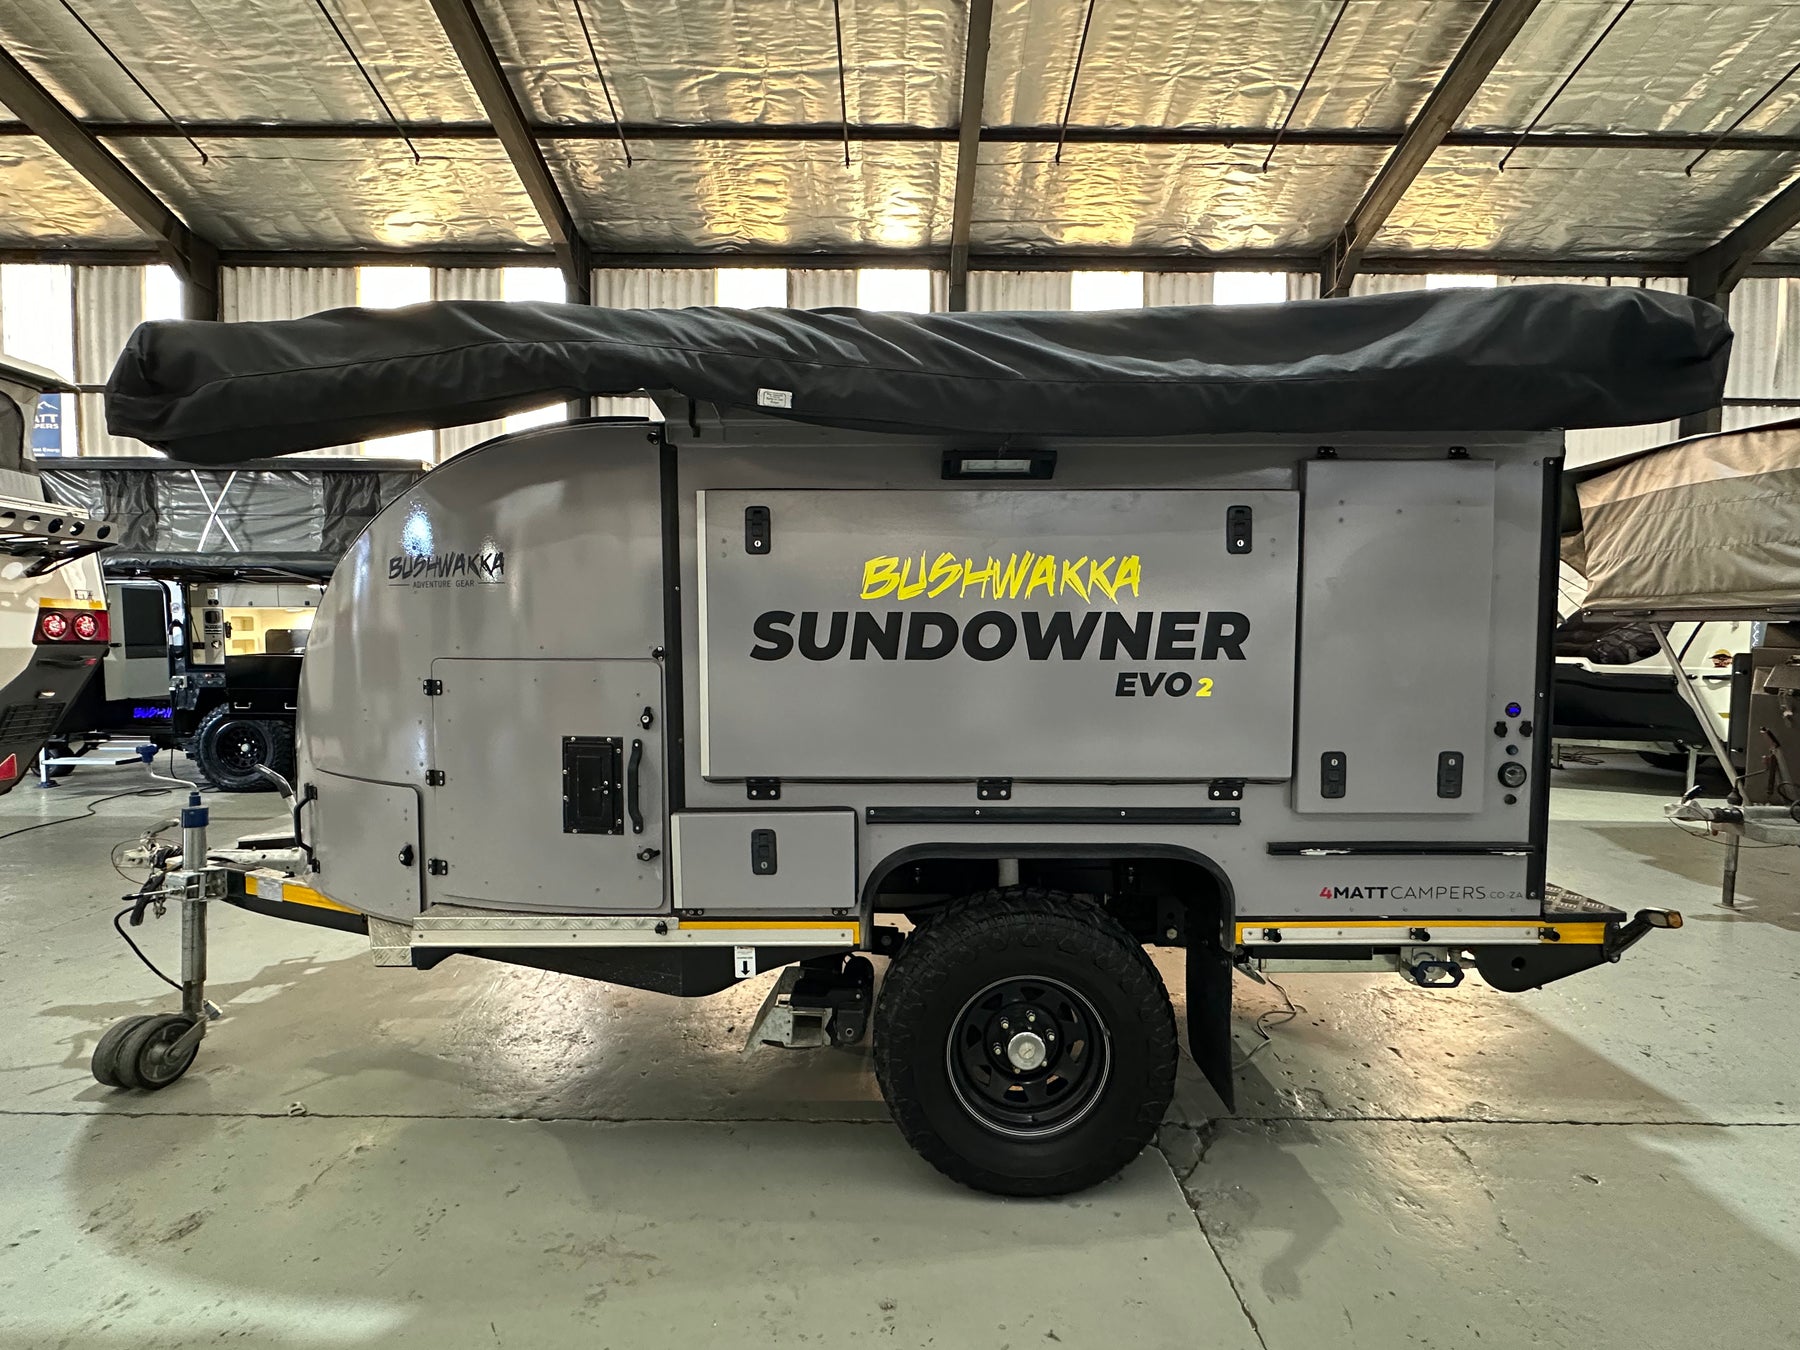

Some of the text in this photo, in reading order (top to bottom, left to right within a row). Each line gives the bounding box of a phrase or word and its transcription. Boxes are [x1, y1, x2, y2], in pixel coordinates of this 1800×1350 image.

[388, 551, 505, 580] BUSHWAKKA
[413, 580, 475, 589] ADVENTURE GEAR
[860, 550, 1140, 604] BUSHWAKKA
[750, 611, 1251, 661] SUNDOWNER
